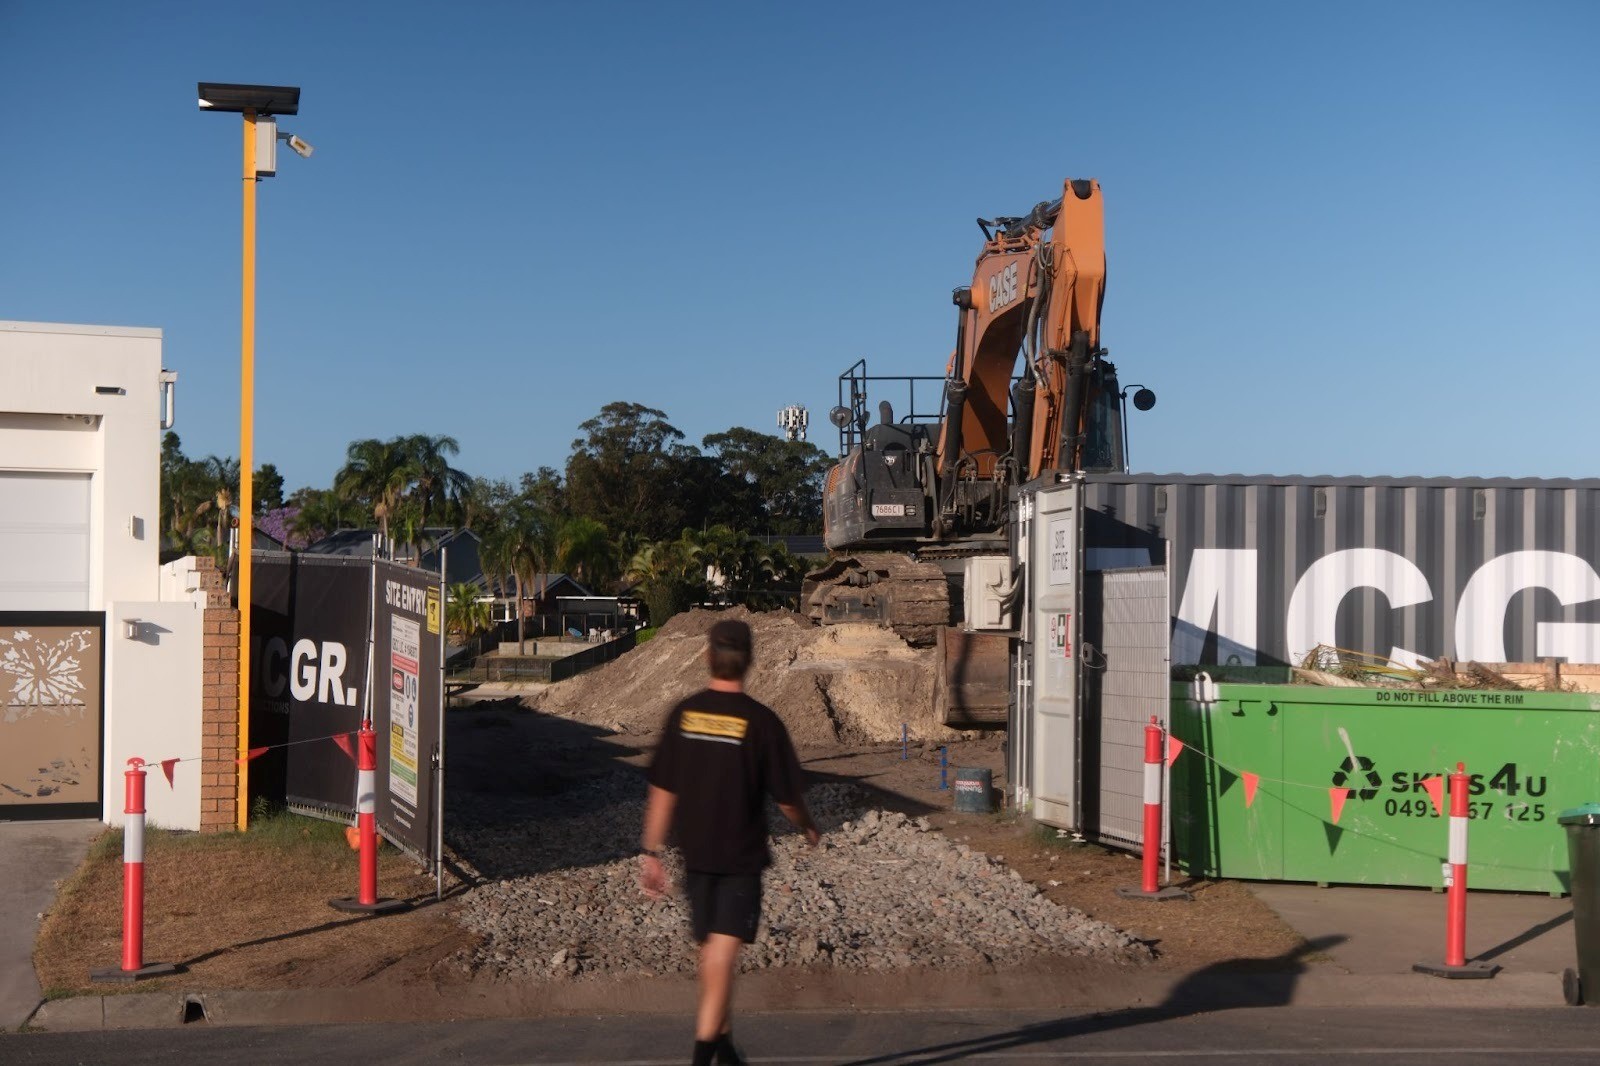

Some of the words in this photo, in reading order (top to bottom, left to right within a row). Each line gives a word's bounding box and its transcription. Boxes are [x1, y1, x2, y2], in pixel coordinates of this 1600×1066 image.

[990, 261, 1018, 314] CASE
[1055, 530, 1065, 549] SITE
[1052, 551, 1068, 571] OFFICE
[385, 579, 401, 608] SITE
[401, 584, 427, 616] ENTRY.
[1376, 691, 1390, 701] DO
[1394, 692, 1415, 702] NOT
[1418, 692, 1439, 702] FILL
[1442, 693, 1477, 703] ABOVE
[1480, 694, 1501, 704] THE
[1505, 694, 1524, 704] RIM
[1391, 762, 1547, 797] SKS4U
[1506, 803, 1545, 821] 125
